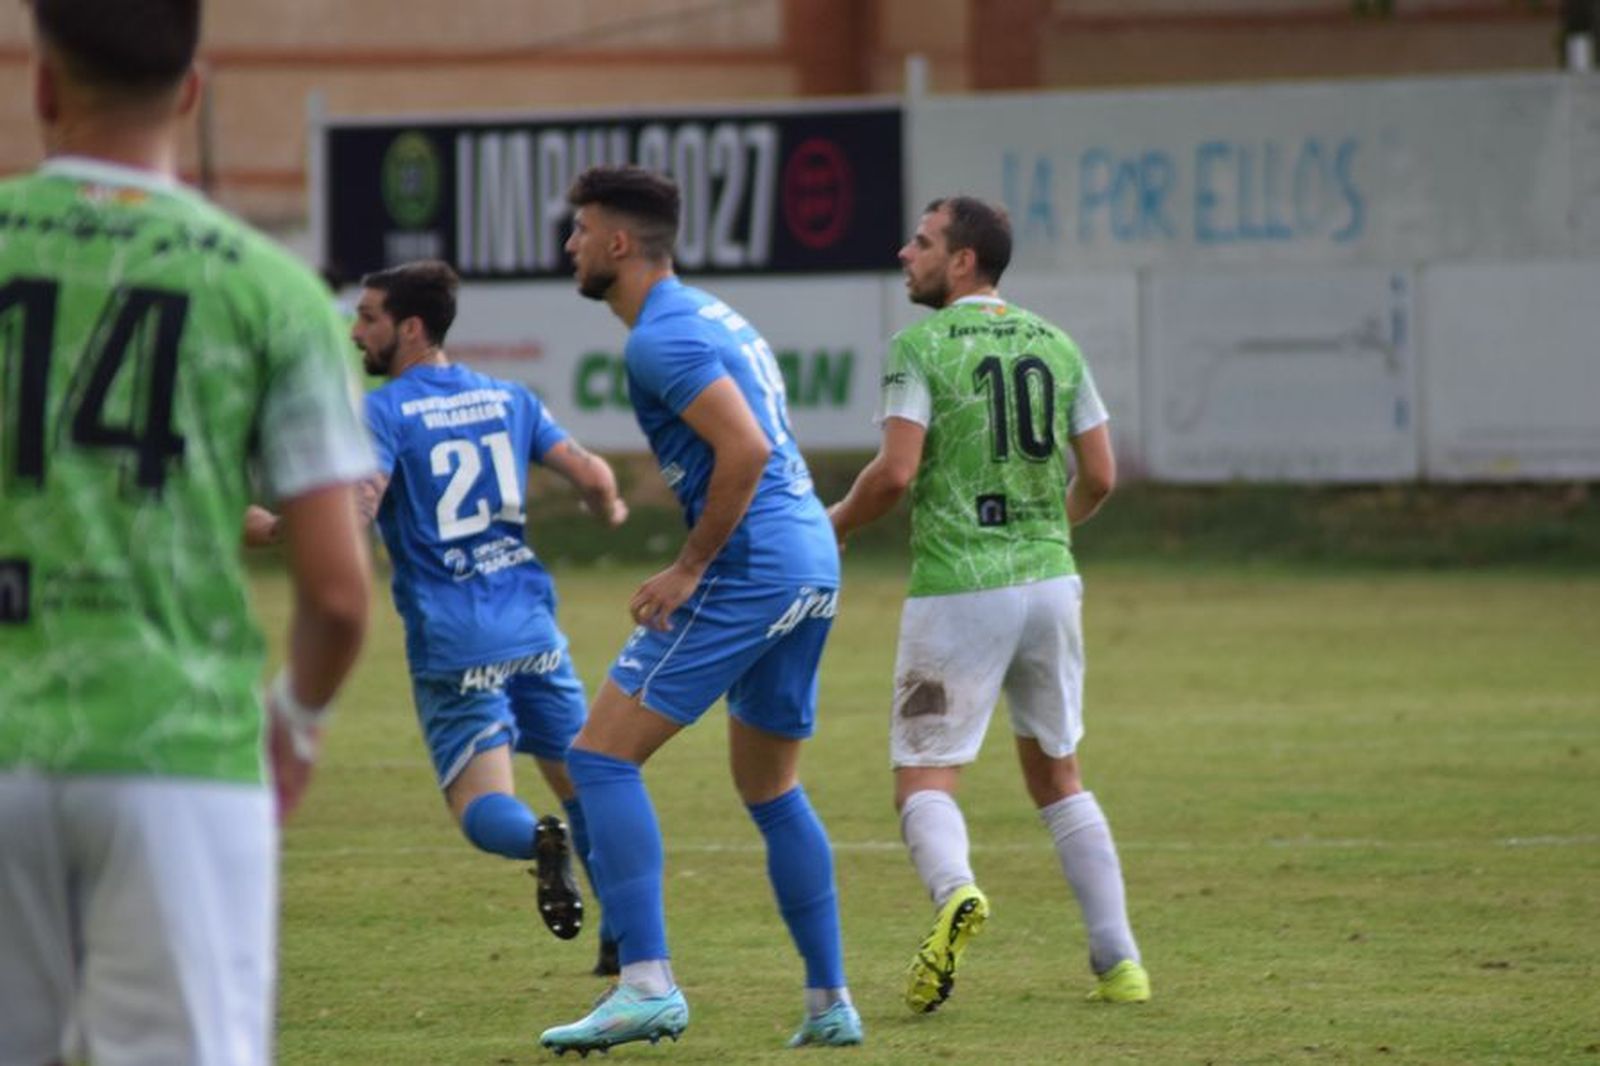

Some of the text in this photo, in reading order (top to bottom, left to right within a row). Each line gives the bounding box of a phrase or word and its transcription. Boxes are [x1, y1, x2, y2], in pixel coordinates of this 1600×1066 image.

[1079, 144, 1180, 243] POR
[1195, 137, 1367, 245] ELLOS
[0, 277, 189, 492] 14
[973, 354, 1055, 463] 10
[430, 430, 526, 541] 21
